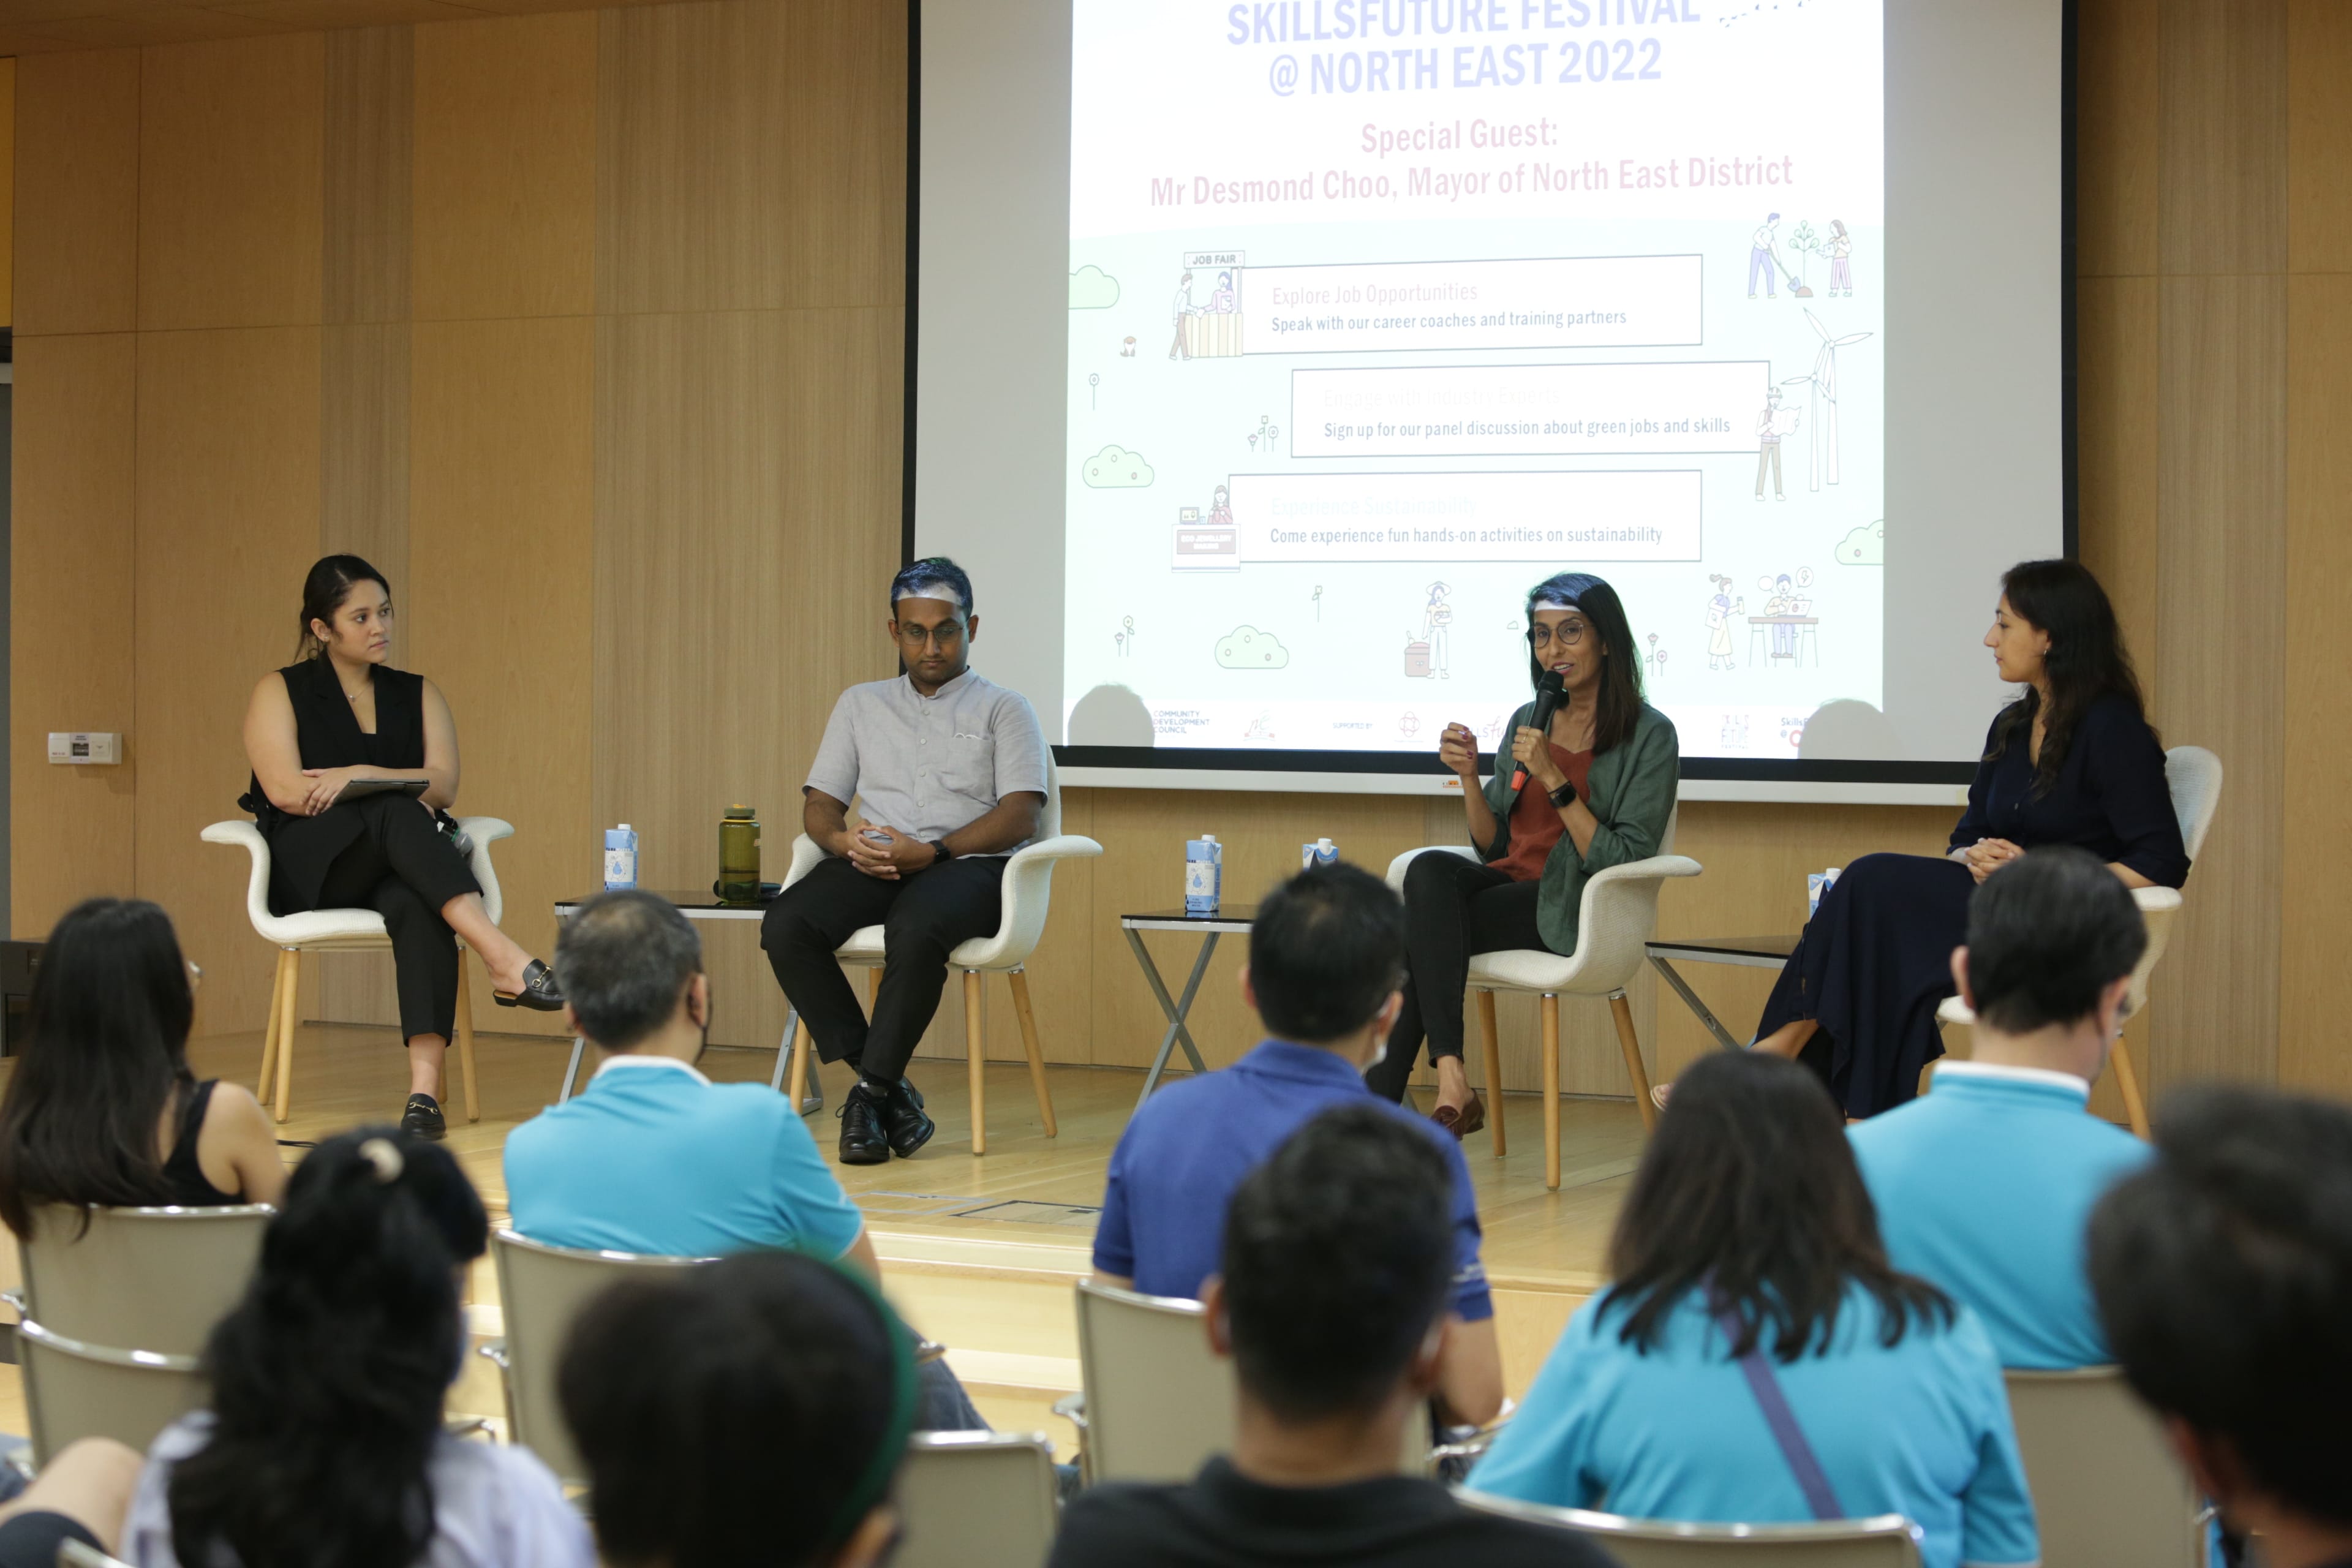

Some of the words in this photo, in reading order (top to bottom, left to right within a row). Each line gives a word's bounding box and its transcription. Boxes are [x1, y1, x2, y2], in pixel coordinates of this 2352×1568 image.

[1228, 0, 1509, 45] SKILLSFUTURE
[1270, 55, 1297, 96] @
[1312, 49, 1437, 93] NORTH
[1454, 43, 1548, 87] EAST
[1559, 39, 1660, 82] 2022
[1362, 120, 1460, 159] Special
[1470, 118, 1556, 148] Guest:
[1152, 178, 1185, 206] Mr
[1194, 172, 1313, 204] Desmond
[1323, 170, 1398, 203] Choo,
[1409, 167, 1490, 202] Mayor
[1499, 163, 1525, 193] of
[1534, 161, 1608, 192] North
[1620, 159, 1679, 189] East
[1689, 156, 1792, 187] District
[1193, 255, 1212, 265] JOB
[1215, 254, 1236, 264] FAIR
[1273, 287, 1330, 309] Explore
[1335, 285, 1361, 303] Job
[1366, 282, 1477, 307] Opportunities
[1272, 317, 1313, 334] Speak
[1317, 316, 1343, 330] with
[1348, 319, 1369, 329] our
[1374, 318, 1416, 328] career
[1420, 313, 1476, 327] coaches
[1480, 312, 1505, 326] and
[1509, 310, 1564, 328] training
[1568, 311, 1626, 328] partners
[1325, 423, 1353, 440] Sign
[1358, 426, 1373, 440] up
[1378, 422, 1395, 436] for
[1400, 425, 1421, 435] our
[1426, 421, 1462, 439] panel
[1467, 421, 1539, 435] discussion
[1544, 420, 1583, 434] about
[1588, 422, 1626, 437] green
[1630, 419, 1659, 437] jobs
[1664, 418, 1688, 432] and
[1694, 418, 1730, 432] skills
[1271, 529, 1306, 543] Come
[1311, 532, 1383, 546] experience
[1389, 528, 1409, 542] fun
[1414, 528, 1476, 541] hands-on
[1480, 528, 1542, 541] activities
[1547, 531, 1562, 541] on
[1568, 527, 1662, 545] sustainability
